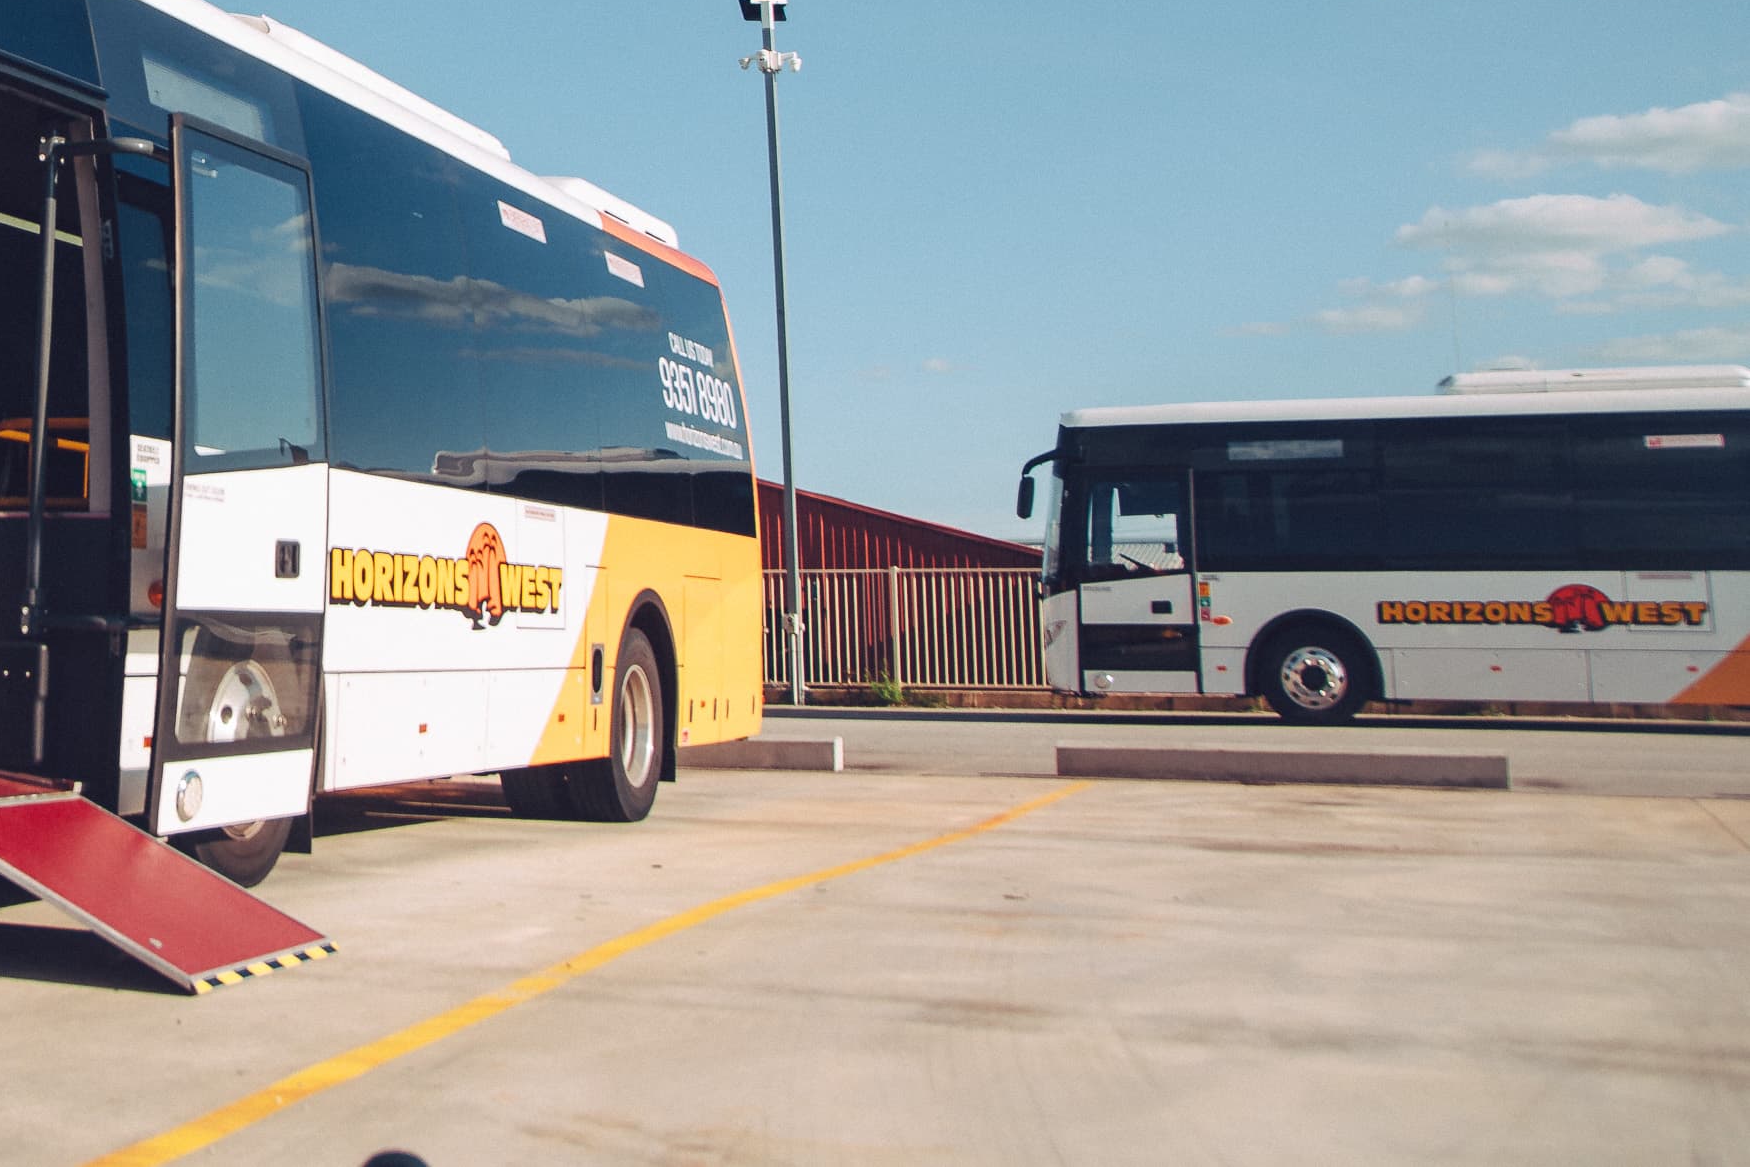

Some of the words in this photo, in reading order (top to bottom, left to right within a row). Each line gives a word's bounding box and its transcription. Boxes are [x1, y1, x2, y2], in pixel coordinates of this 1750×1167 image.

[668, 331, 688, 358] CALL
[683, 338, 697, 362] US
[658, 356, 699, 416] 9351
[695, 370, 738, 430] 8980
[329, 547, 470, 610] HORIZONS
[499, 562, 563, 614] WEST
[1377, 600, 1554, 626] HORIZONS
[1600, 600, 1707, 626] WEST
